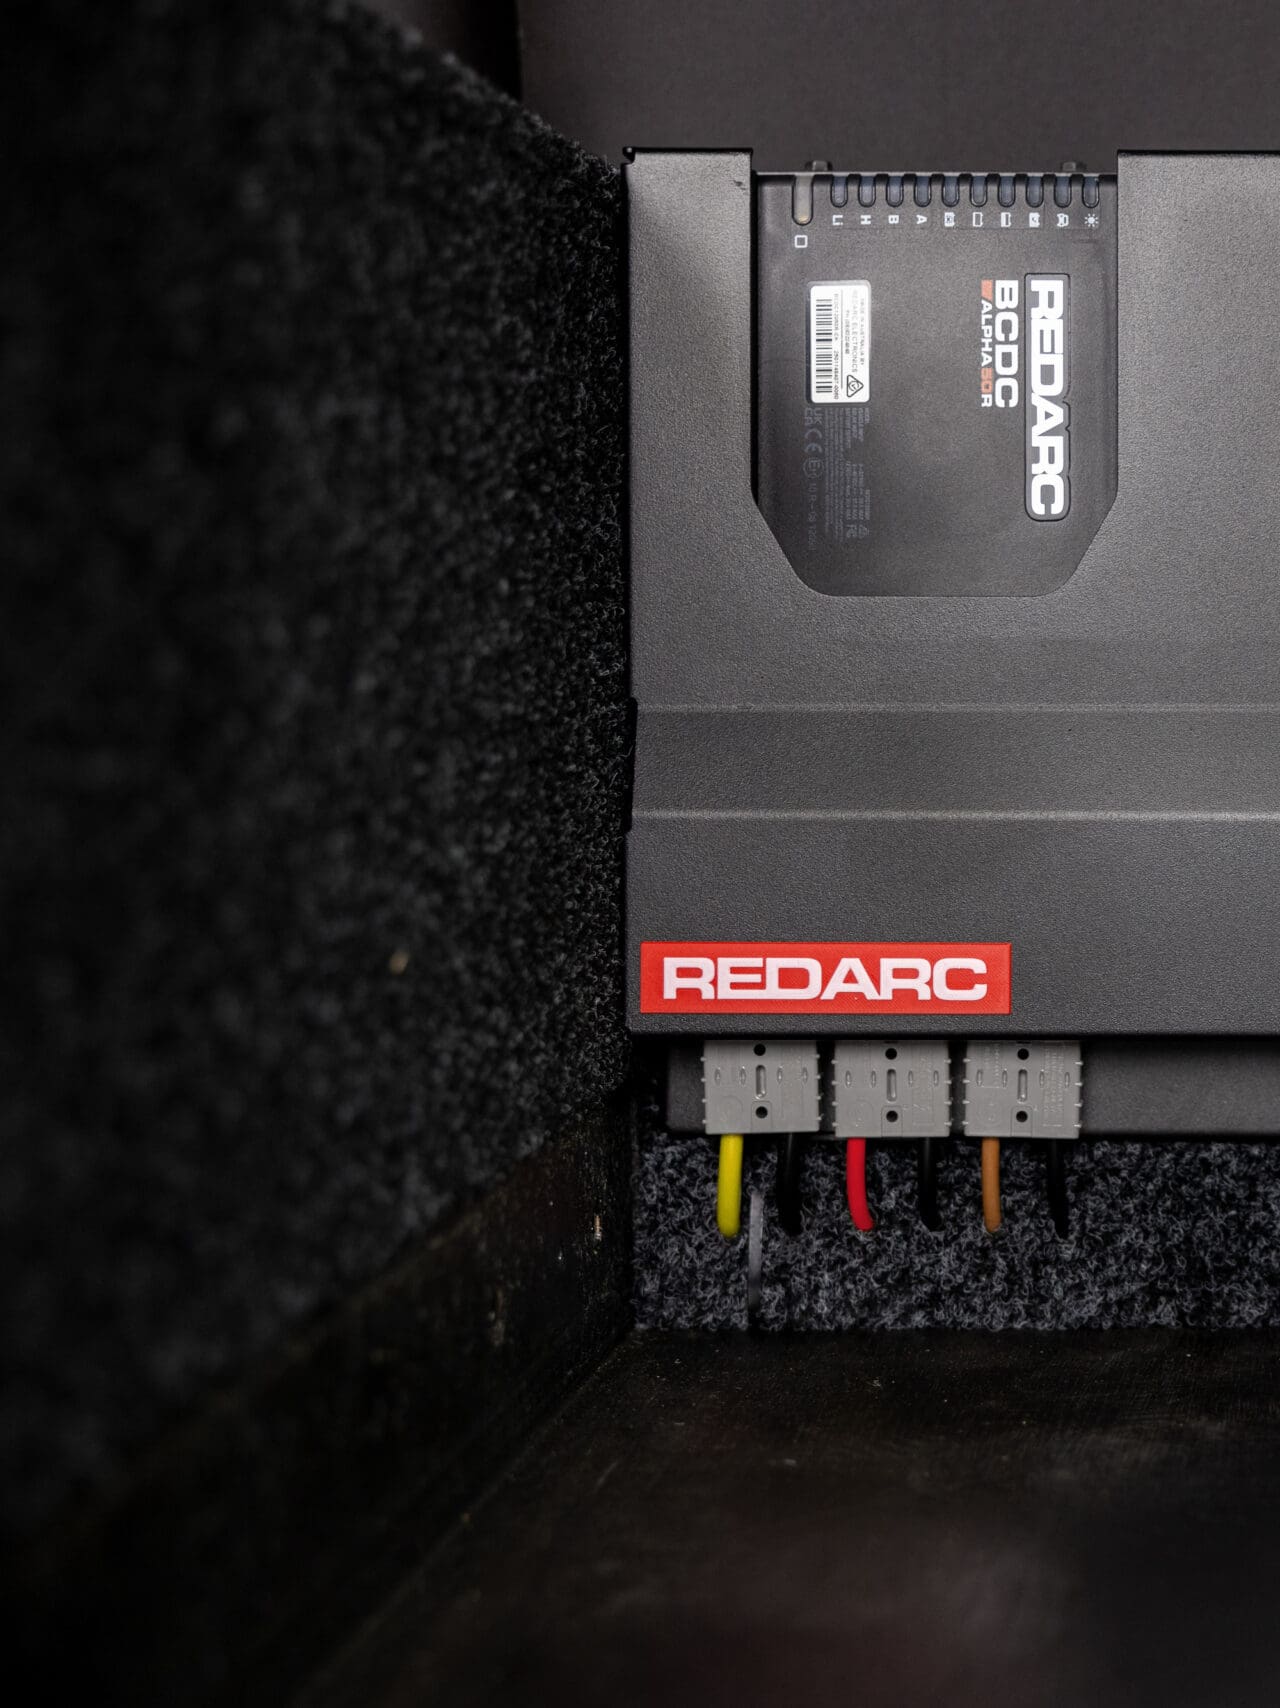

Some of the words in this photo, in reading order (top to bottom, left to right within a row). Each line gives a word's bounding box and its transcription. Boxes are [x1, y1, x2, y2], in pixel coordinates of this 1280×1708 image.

[832, 215, 844, 225] Li
[861, 215, 871, 225] H
[889, 215, 899, 225] B
[916, 215, 927, 225] A
[994, 279, 1019, 408] BCDC
[1030, 279, 1065, 515] REDARC
[663, 956, 988, 1001] REDARC
